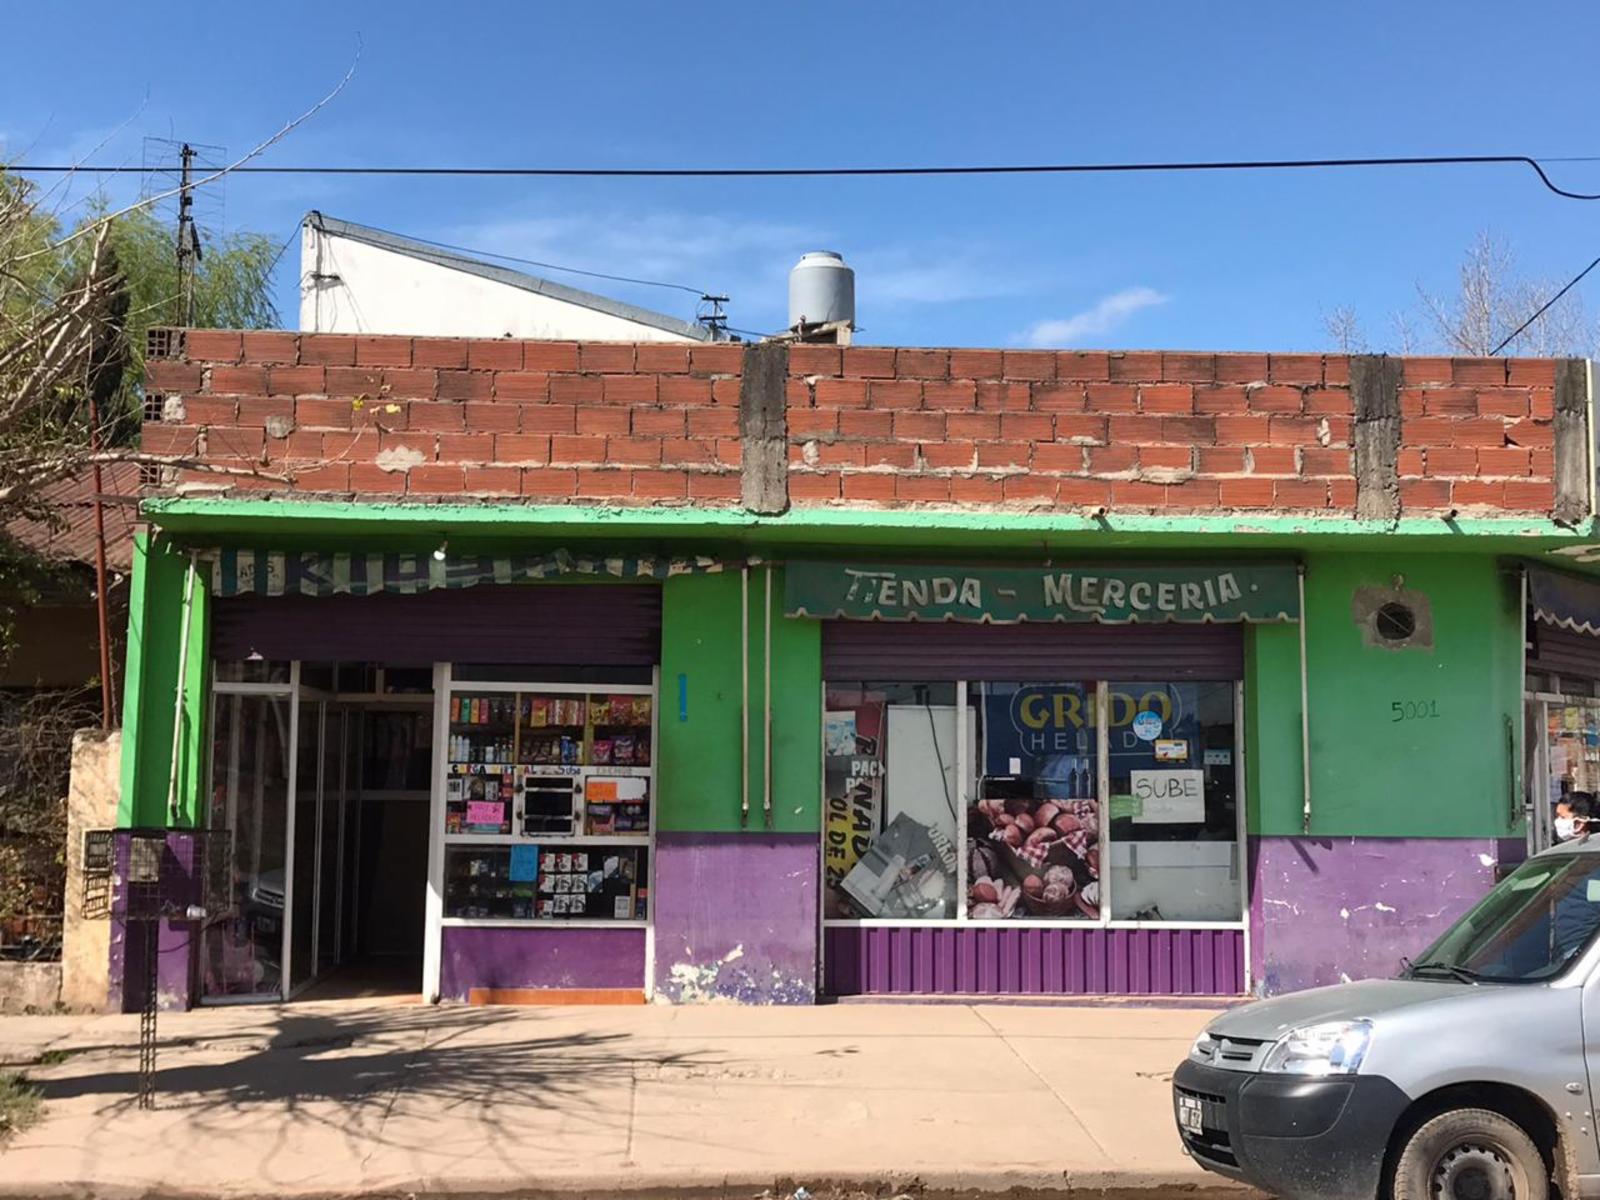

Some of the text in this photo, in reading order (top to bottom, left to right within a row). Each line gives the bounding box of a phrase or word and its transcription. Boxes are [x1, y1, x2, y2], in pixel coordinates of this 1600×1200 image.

[1043, 572, 1242, 614] MERCERIA
[1020, 690, 1172, 729] GRIDO
[1391, 699, 1441, 723] 5001
[1031, 731, 1163, 751] HELD
[1136, 778, 1199, 799] SUBE
